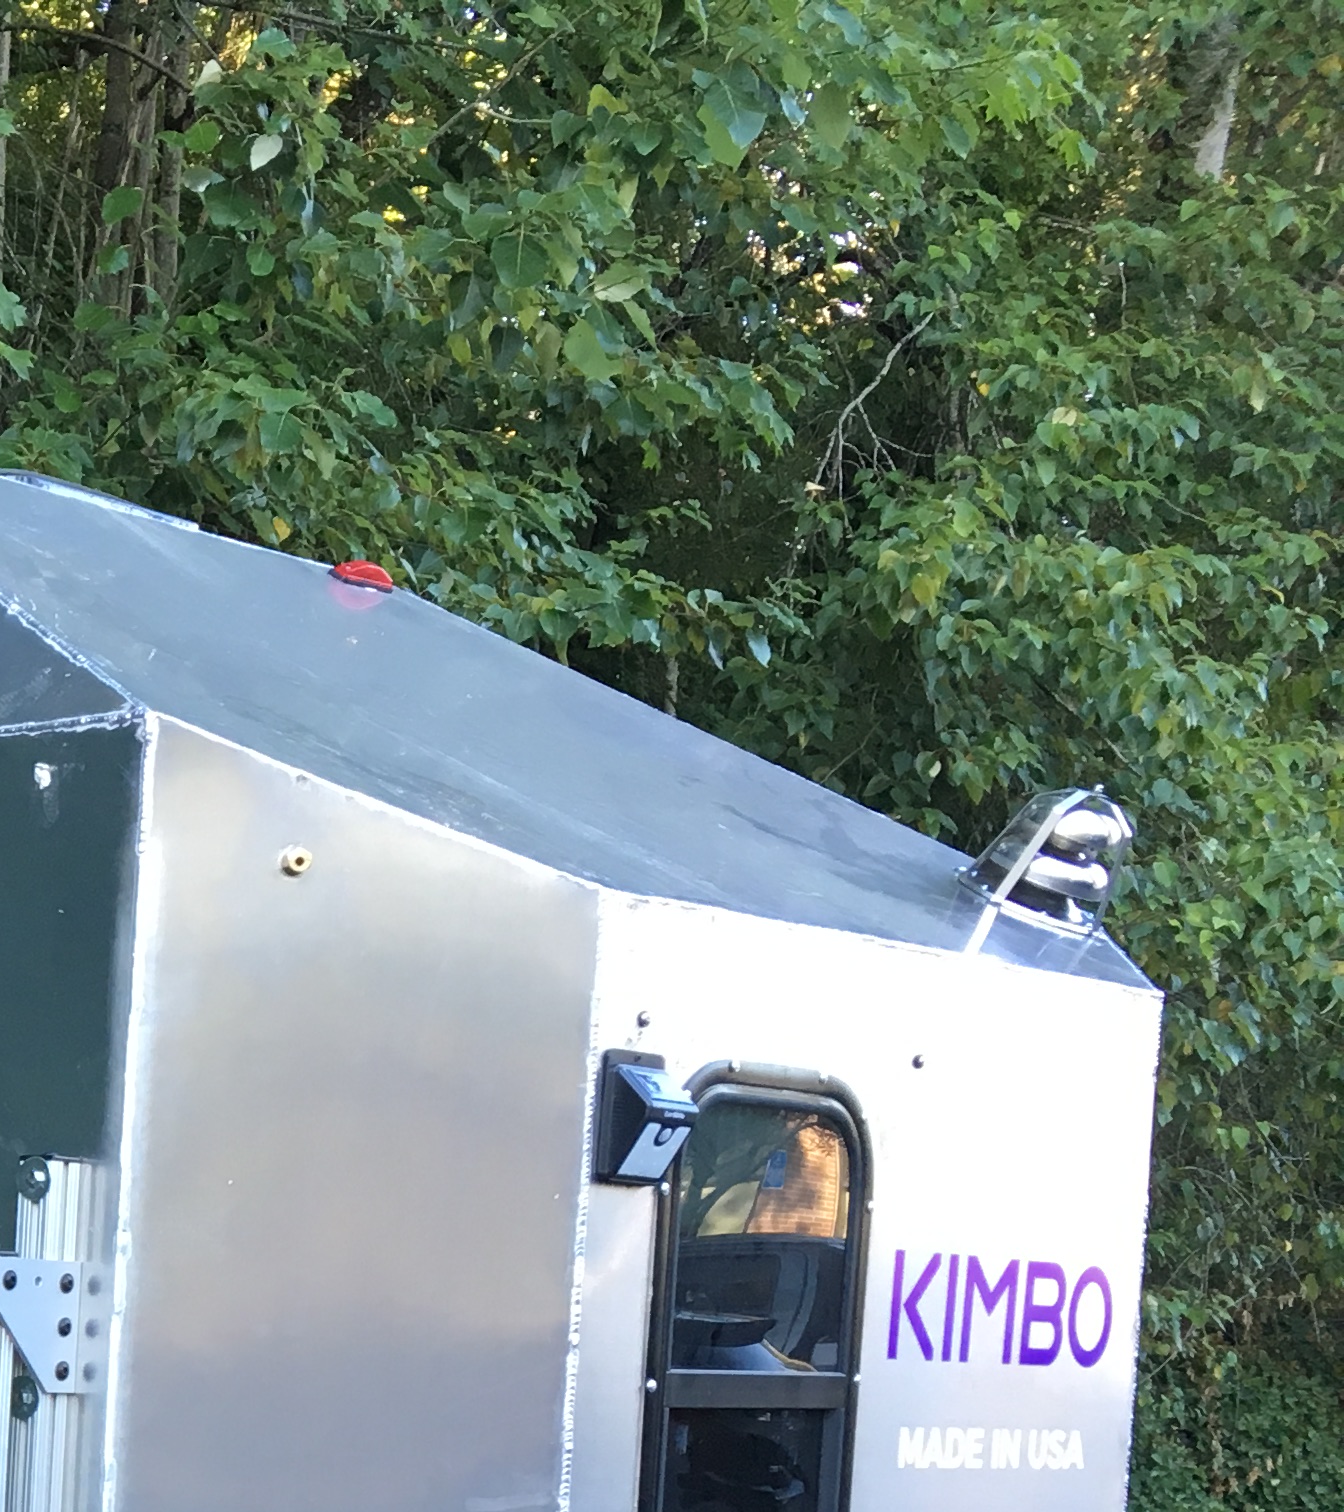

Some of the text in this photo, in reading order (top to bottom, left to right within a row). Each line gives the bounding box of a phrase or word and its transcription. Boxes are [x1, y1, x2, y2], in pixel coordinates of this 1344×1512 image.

[886, 1249, 1113, 1369] KIMBO
[897, 1426, 1085, 1470] MADE IN USA
